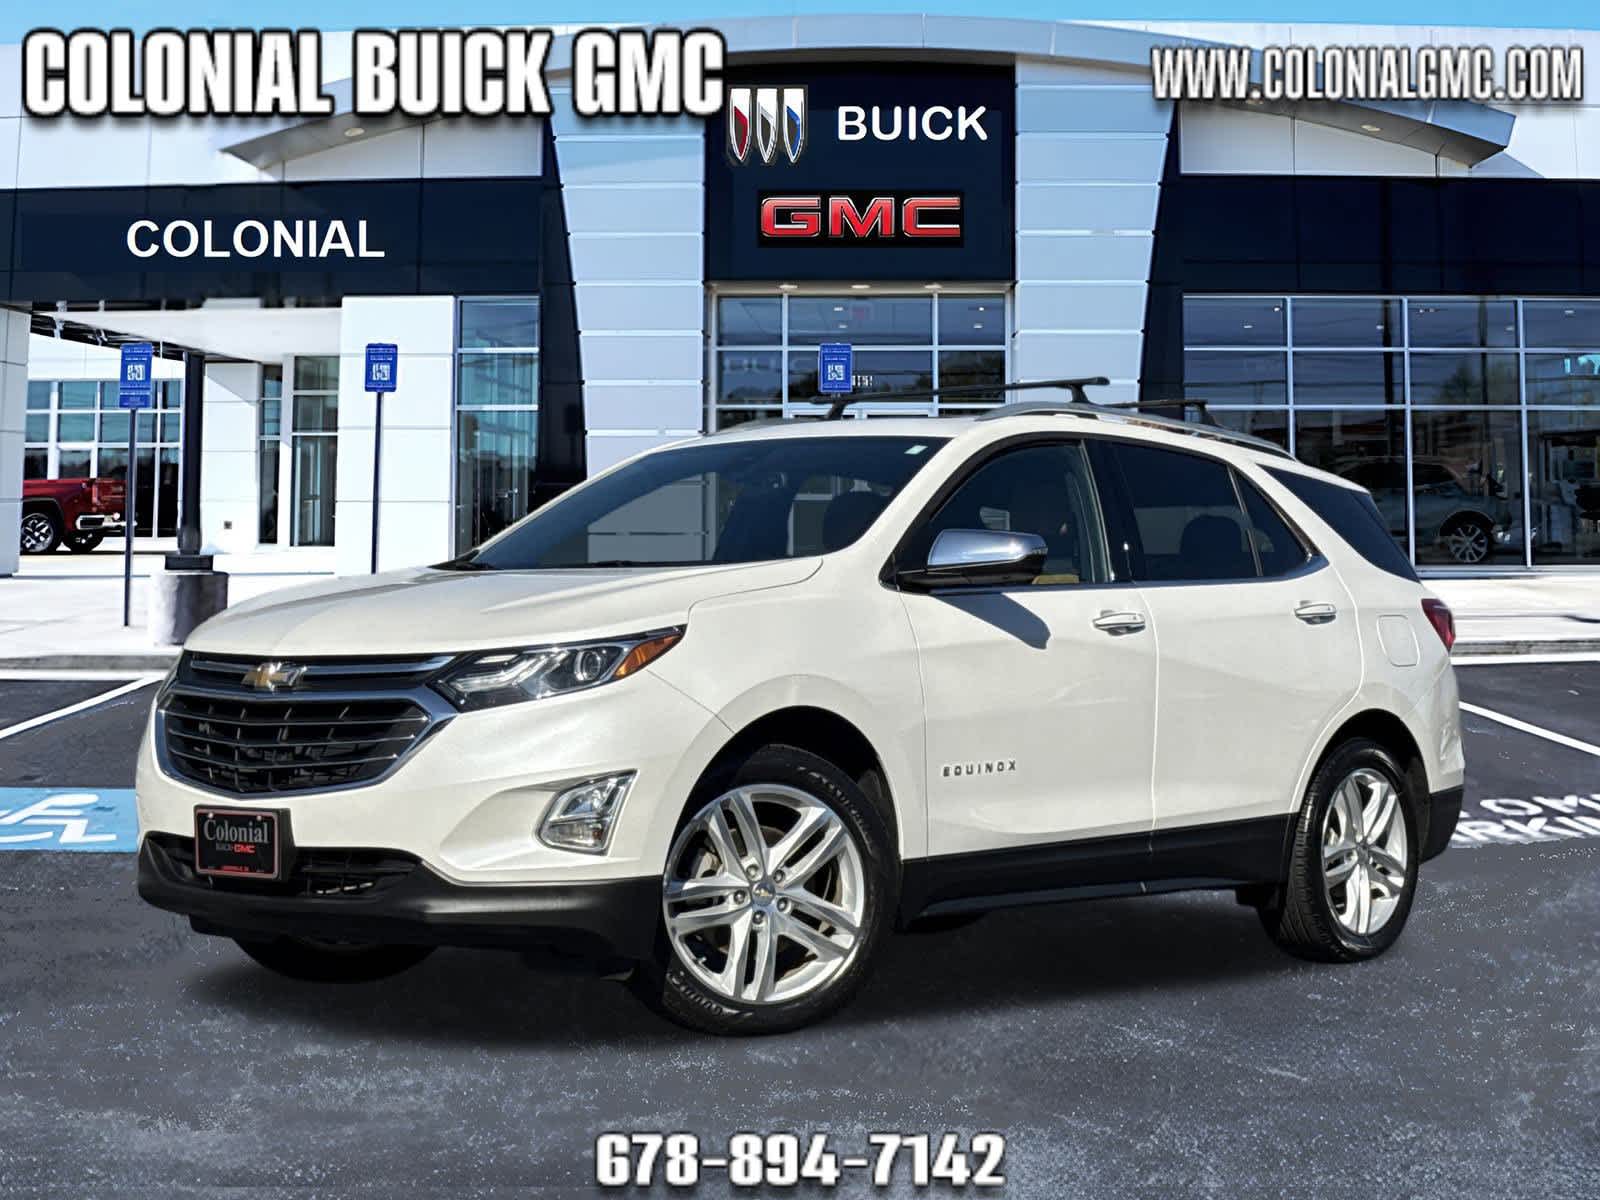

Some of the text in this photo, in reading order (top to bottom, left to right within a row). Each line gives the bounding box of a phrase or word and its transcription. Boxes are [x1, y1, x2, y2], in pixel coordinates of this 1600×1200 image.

[837, 105, 989, 141] BUICK
[760, 196, 962, 238] GMC
[127, 219, 386, 258] COLONIAL
[943, 760, 1016, 777] EQUINOX
[203, 819, 270, 844] Colonial
